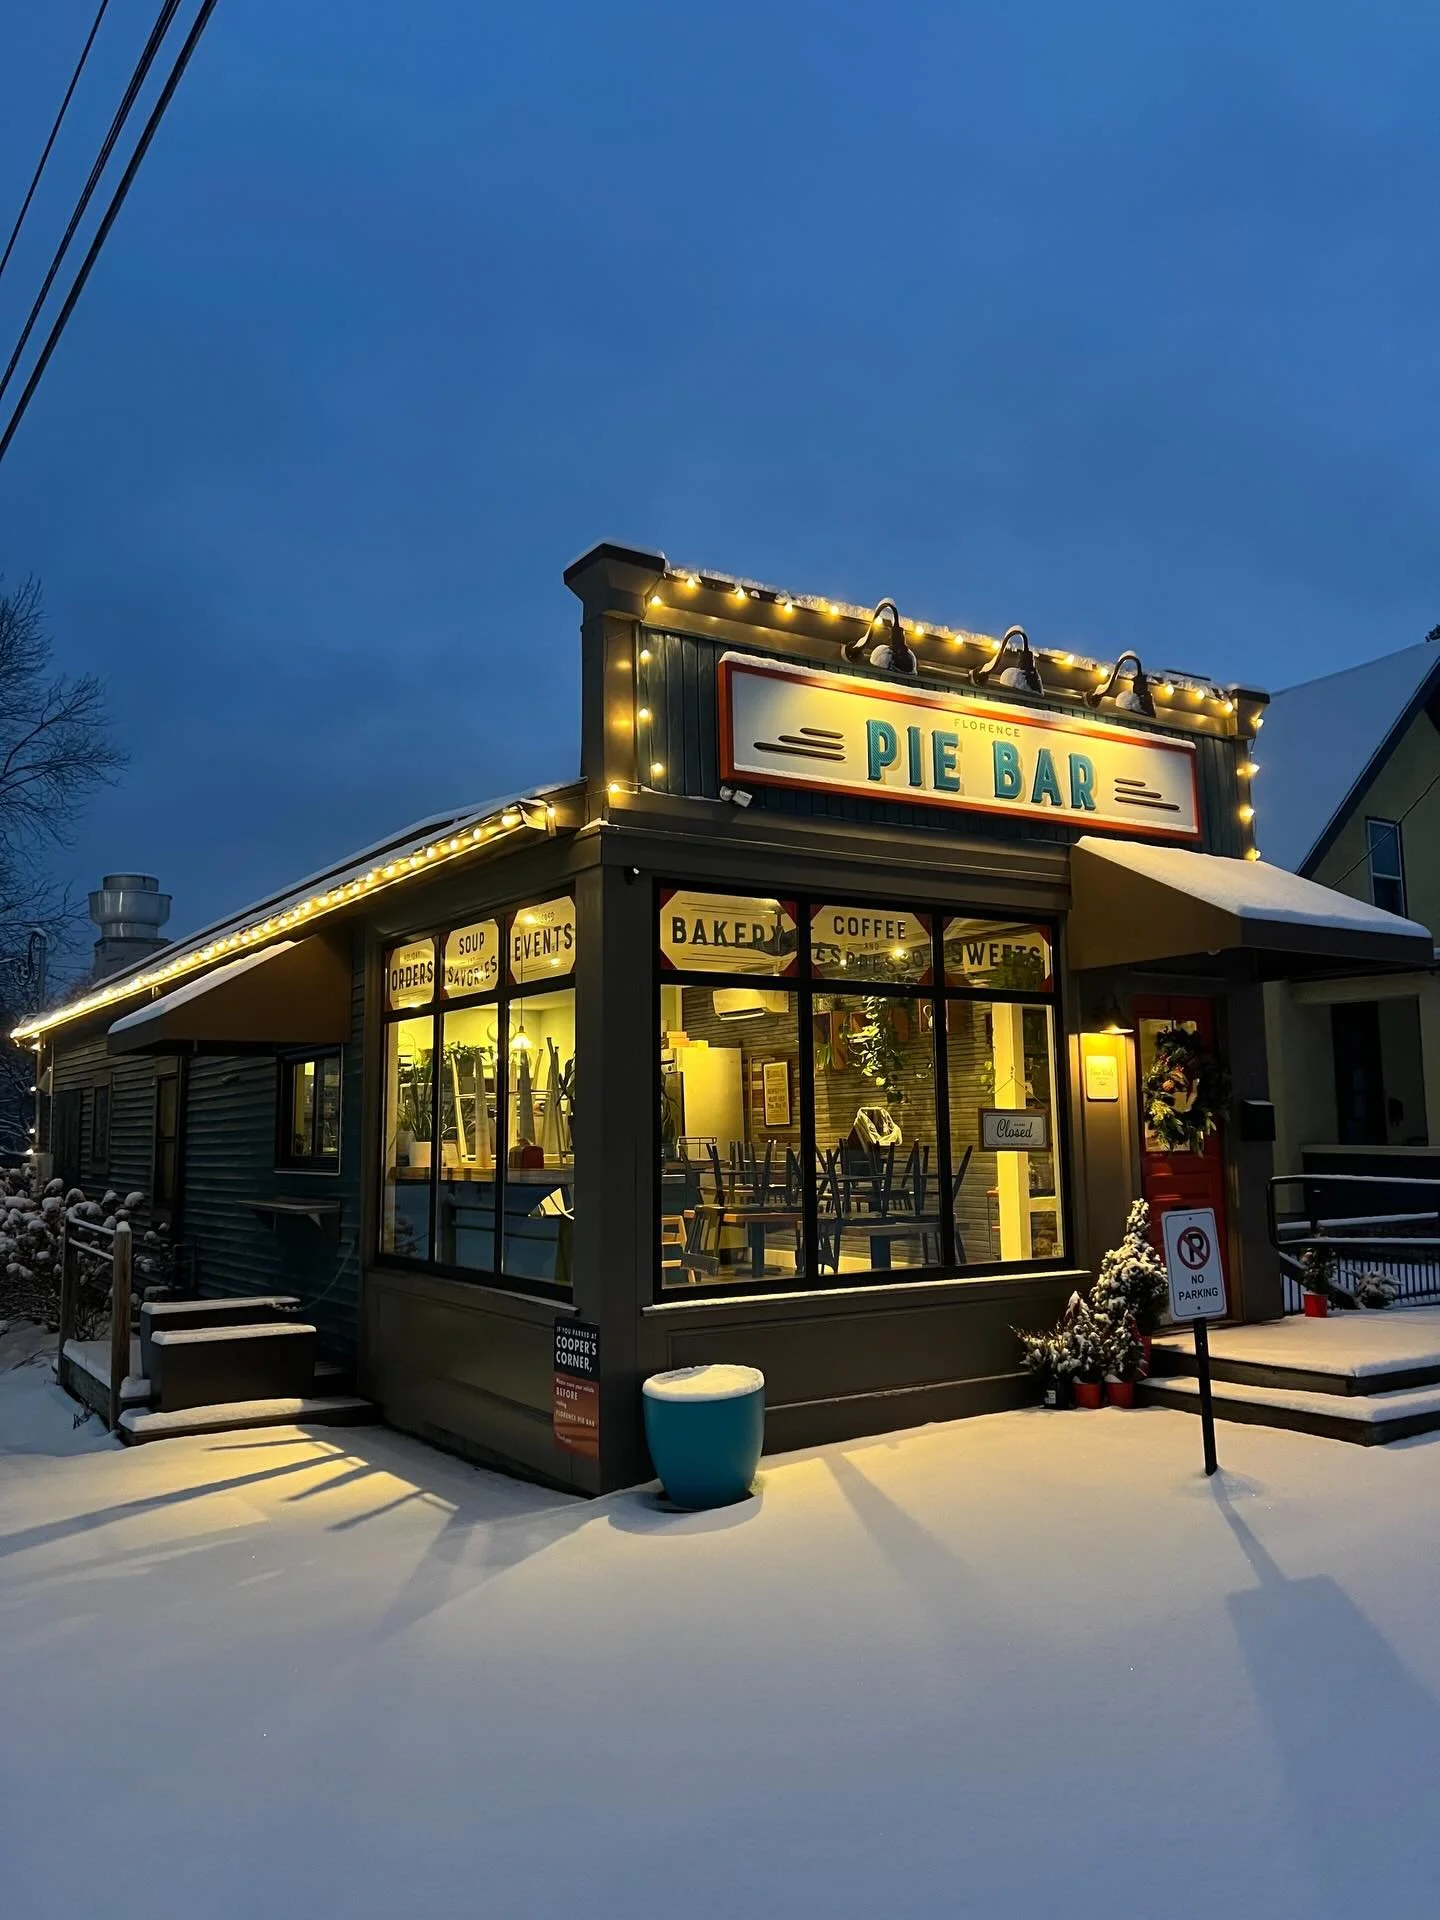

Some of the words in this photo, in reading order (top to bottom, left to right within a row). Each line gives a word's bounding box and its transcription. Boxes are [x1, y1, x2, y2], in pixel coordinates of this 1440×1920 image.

[953, 718, 1021, 738] FLORENCE
[866, 719, 962, 793] PIE
[991, 740, 1097, 811] BAR
[671, 916, 785, 948] BAKERY
[833, 915, 906, 940] COFFEE
[459, 932, 485, 955] SOUP
[514, 922, 572, 962] EVENTS
[864, 942, 880, 951] AND
[951, 942, 1043, 967] SWEETS
[391, 960, 433, 991] ORDERS
[448, 955, 497, 987] SAVORIES
[996, 1118, 1033, 1138] Closed
[1191, 1274, 1204, 1285] NO
[1178, 1287, 1219, 1301] PARKING
[556, 1335, 597, 1356] COOPER'S
[556, 1350, 592, 1373] CORNER,
[556, 1386, 578, 1400] BEFORE
